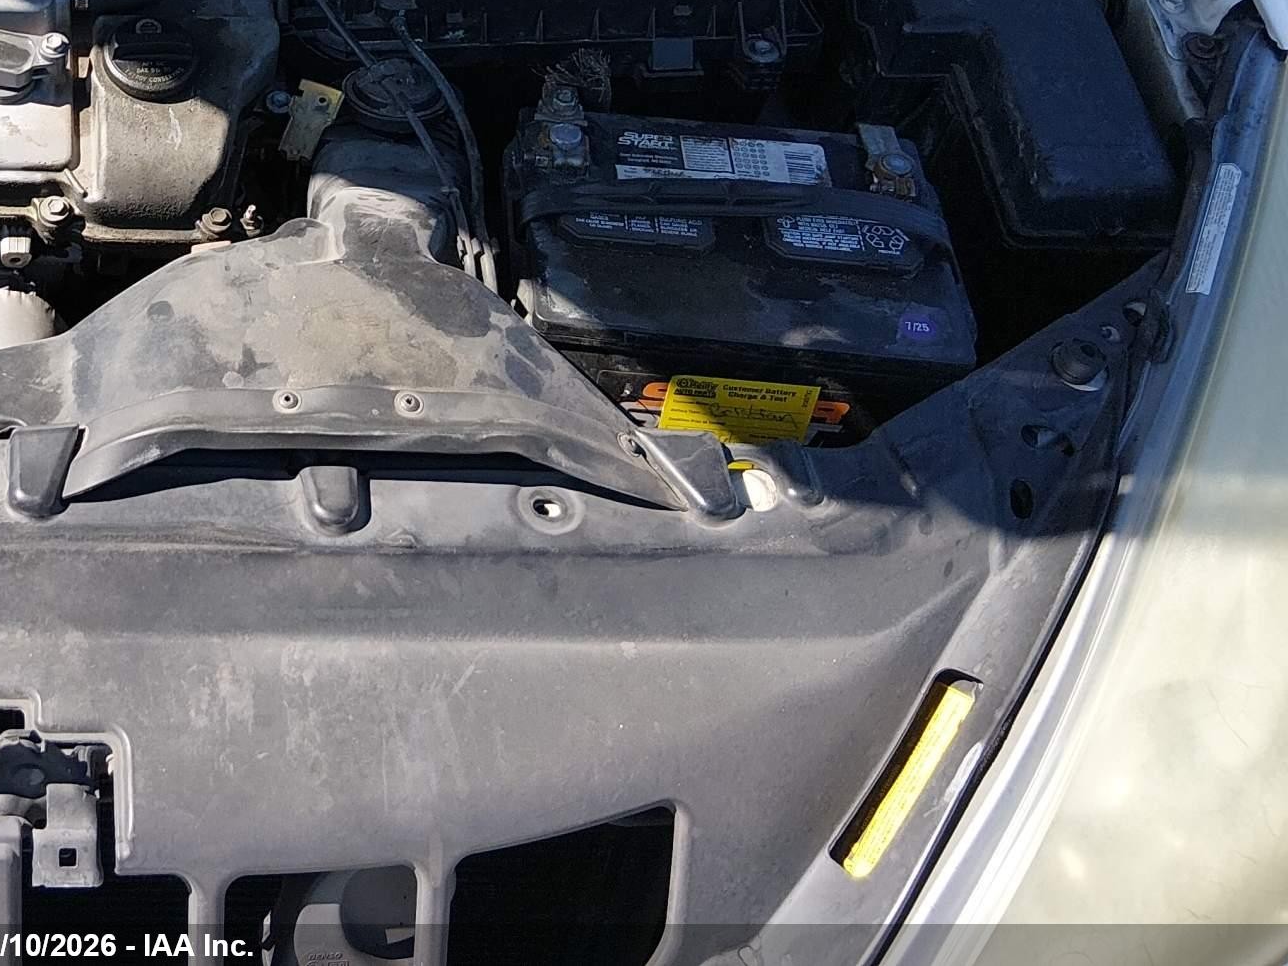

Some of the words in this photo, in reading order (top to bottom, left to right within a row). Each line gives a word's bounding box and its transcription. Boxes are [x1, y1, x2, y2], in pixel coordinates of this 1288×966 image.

[904, 321, 930, 332] 7/25
[723, 384, 764, 395] Customer
[766, 387, 797, 398] Battery
[728, 391, 758, 401] Charge
